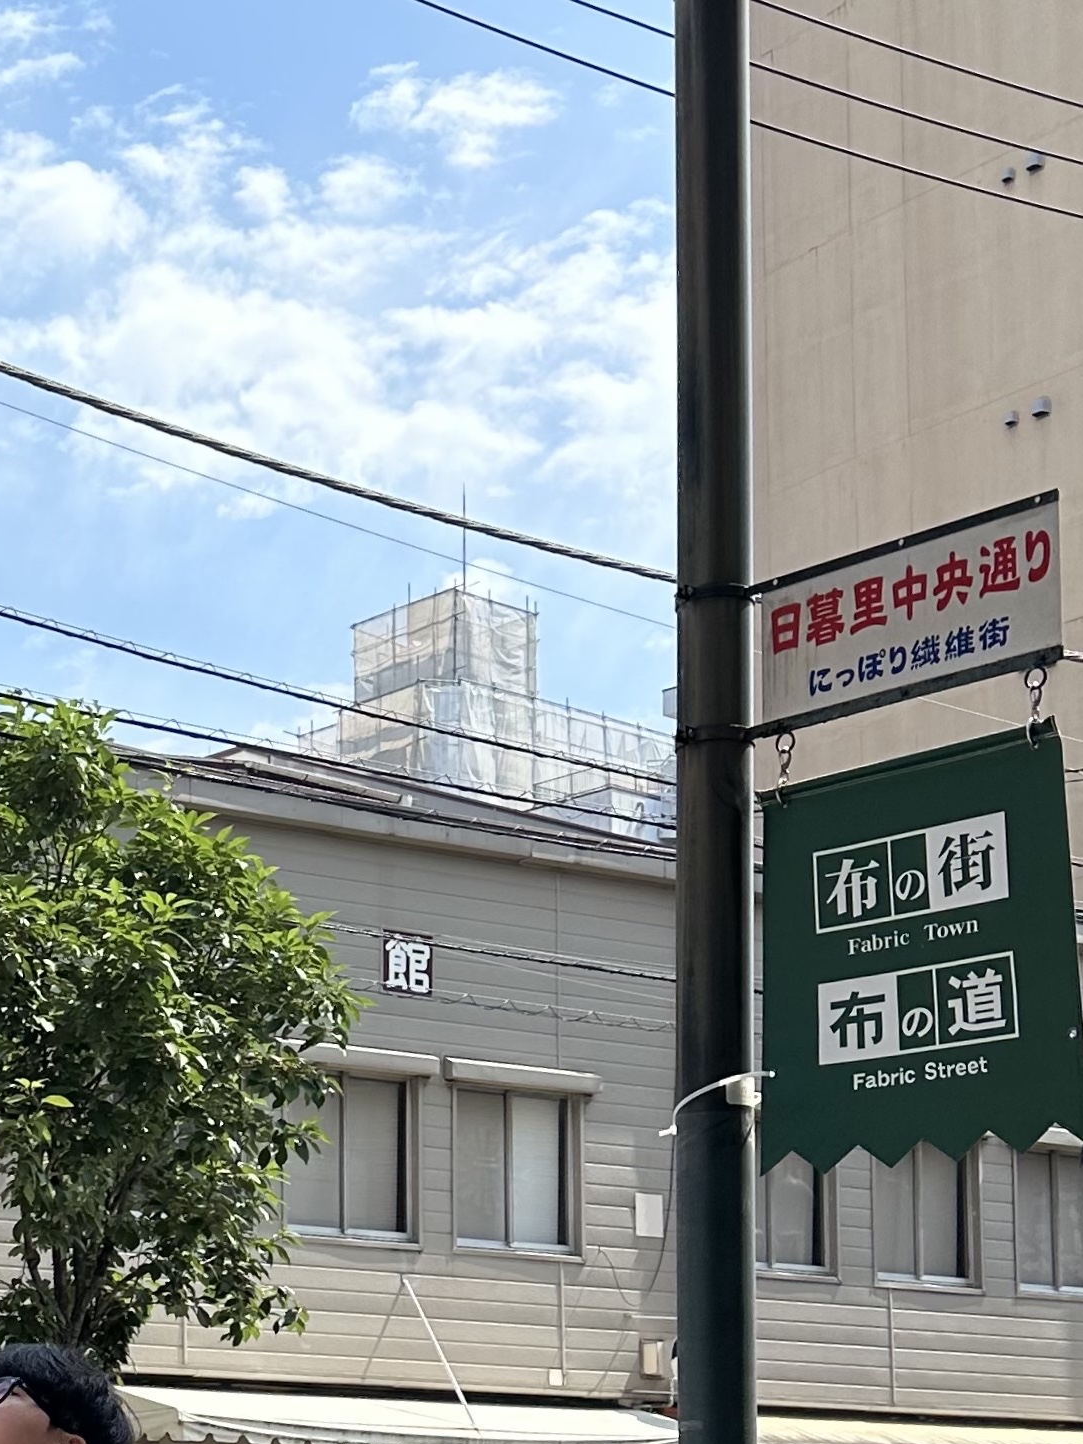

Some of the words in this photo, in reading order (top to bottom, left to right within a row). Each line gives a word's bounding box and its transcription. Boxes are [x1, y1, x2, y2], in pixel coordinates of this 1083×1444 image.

[771, 529, 1051, 656] 日暮里中央通り
[809, 615, 1010, 697] にっぽり繊維街
[824, 829, 995, 918] 布の街
[847, 929, 910, 955] Fabric
[923, 918, 979, 941] Town
[829, 967, 1007, 1050] 布の道
[852, 1066, 916, 1091] Fabric
[924, 1055, 989, 1081] Street
